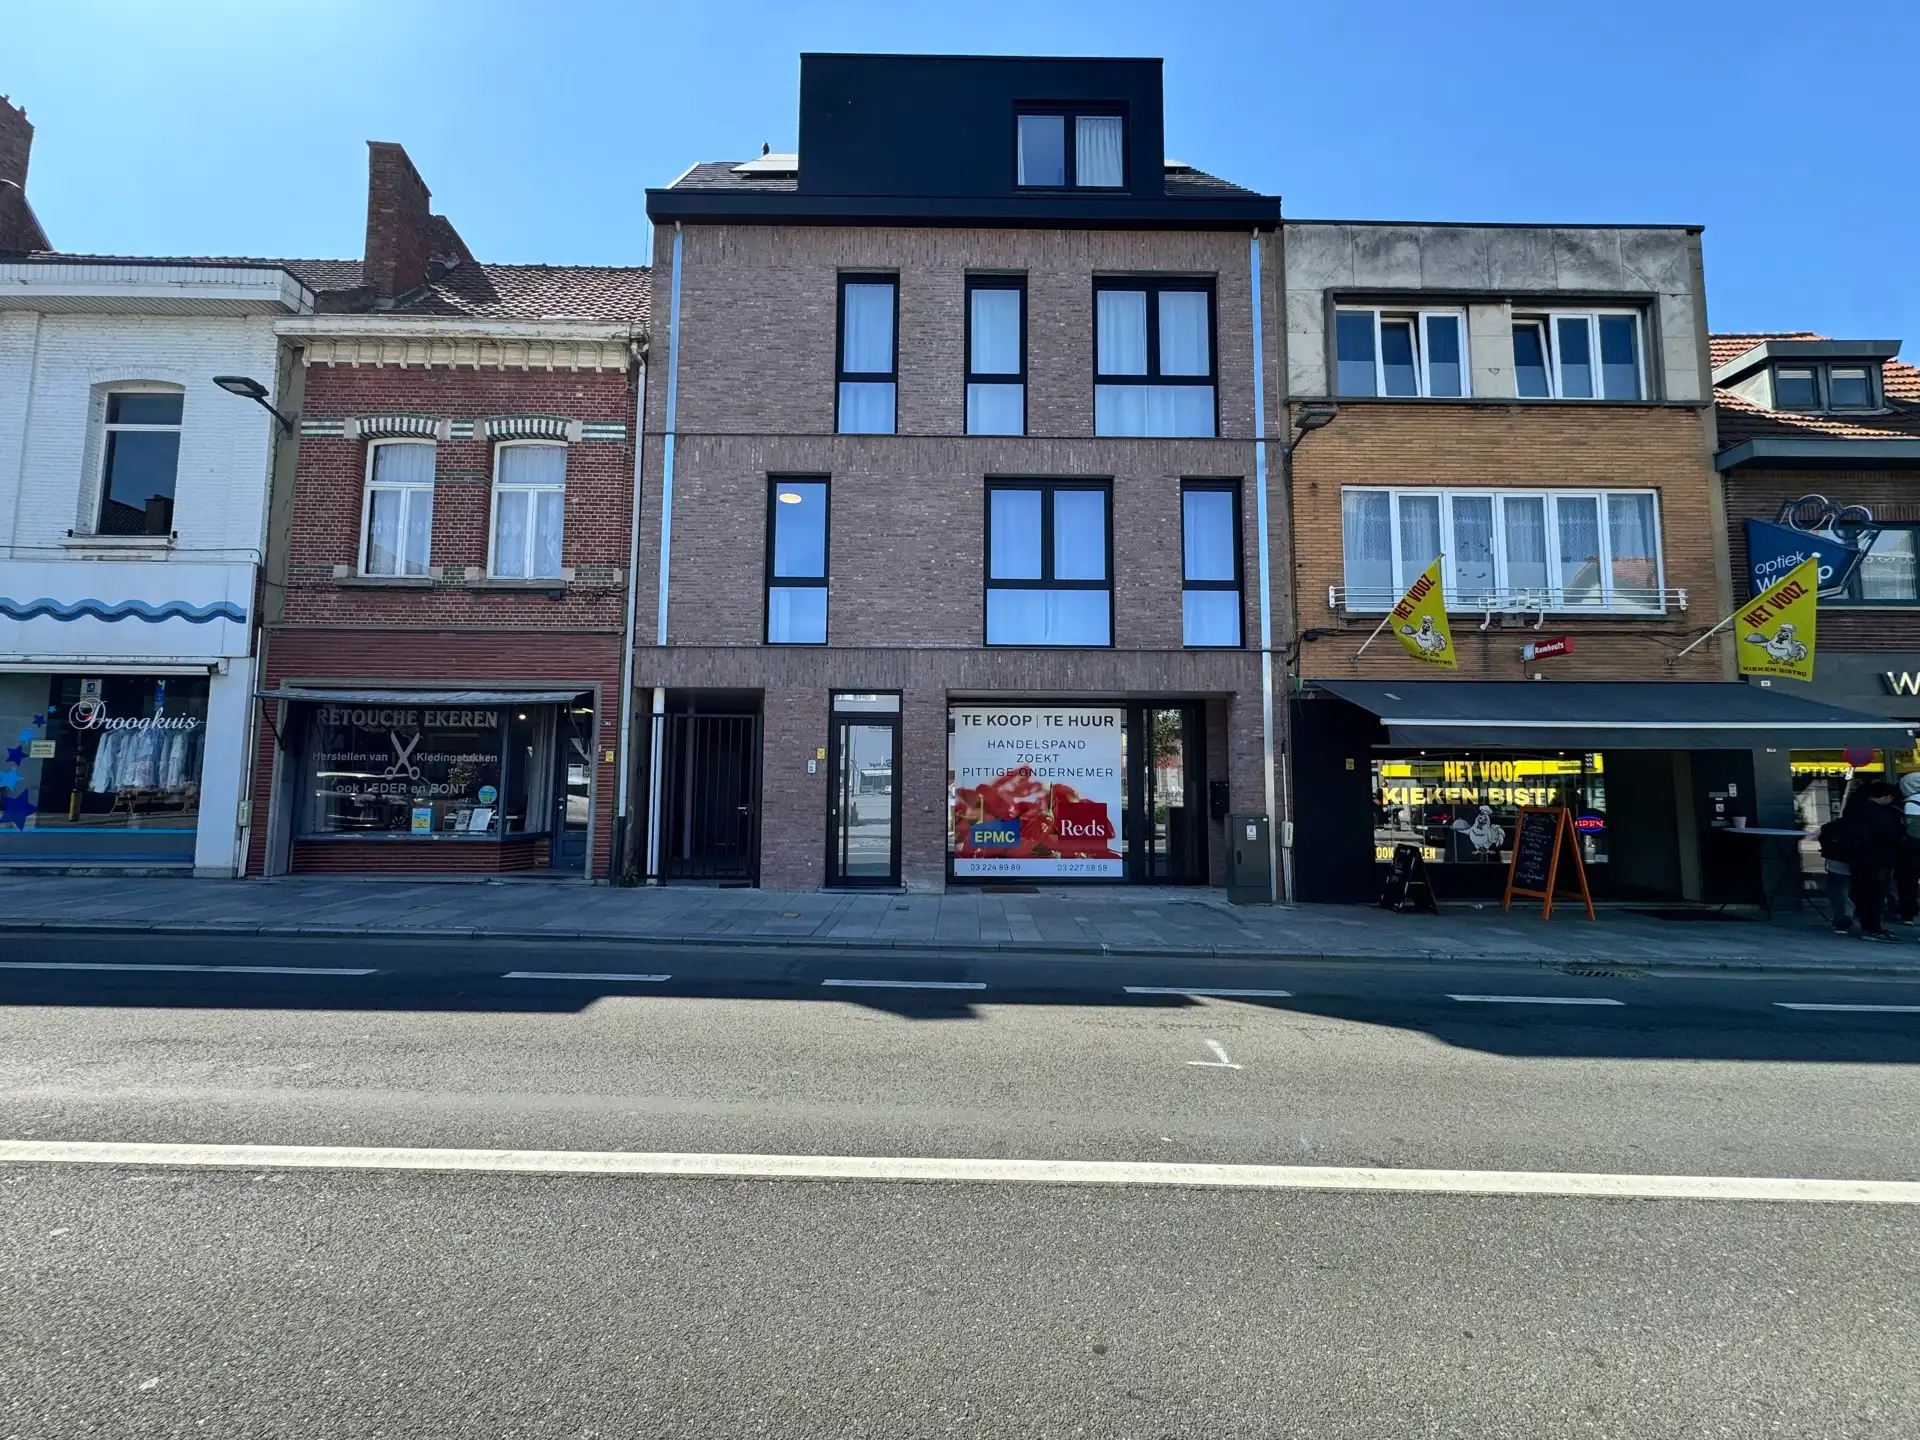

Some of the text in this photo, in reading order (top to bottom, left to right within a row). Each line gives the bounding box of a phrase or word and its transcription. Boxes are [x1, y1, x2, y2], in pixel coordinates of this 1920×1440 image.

[1755, 550, 1805, 575] optiek
[1393, 573, 1435, 620] HET VOOZ
[1742, 580, 1809, 628] HET VOOZ
[1779, 667, 1808, 677] BISTRO
[69, 698, 200, 737] Droogkuis
[316, 709, 499, 728] RETOUCHE EKEREN
[961, 714, 1114, 727] TE KOOP TE HUUR
[987, 740, 1086, 749] HANDELSPAND
[312, 752, 366, 762] Herstellen
[369, 754, 388, 762] van
[1016, 753, 1060, 763] ZOEKT
[962, 767, 1113, 777] PITTIGE ONDERNEMER
[1443, 761, 1523, 782] HET VOOZ
[336, 783, 467, 794] ook LEDER en BONT
[1382, 787, 1478, 805] KIEKEN
[1060, 819, 1105, 836] Reds
[974, 831, 1015, 843] EPMC
[1375, 847, 1394, 859] OOK
[1057, 864, 1068, 872] 03
[1069, 864, 1083, 872] 227
